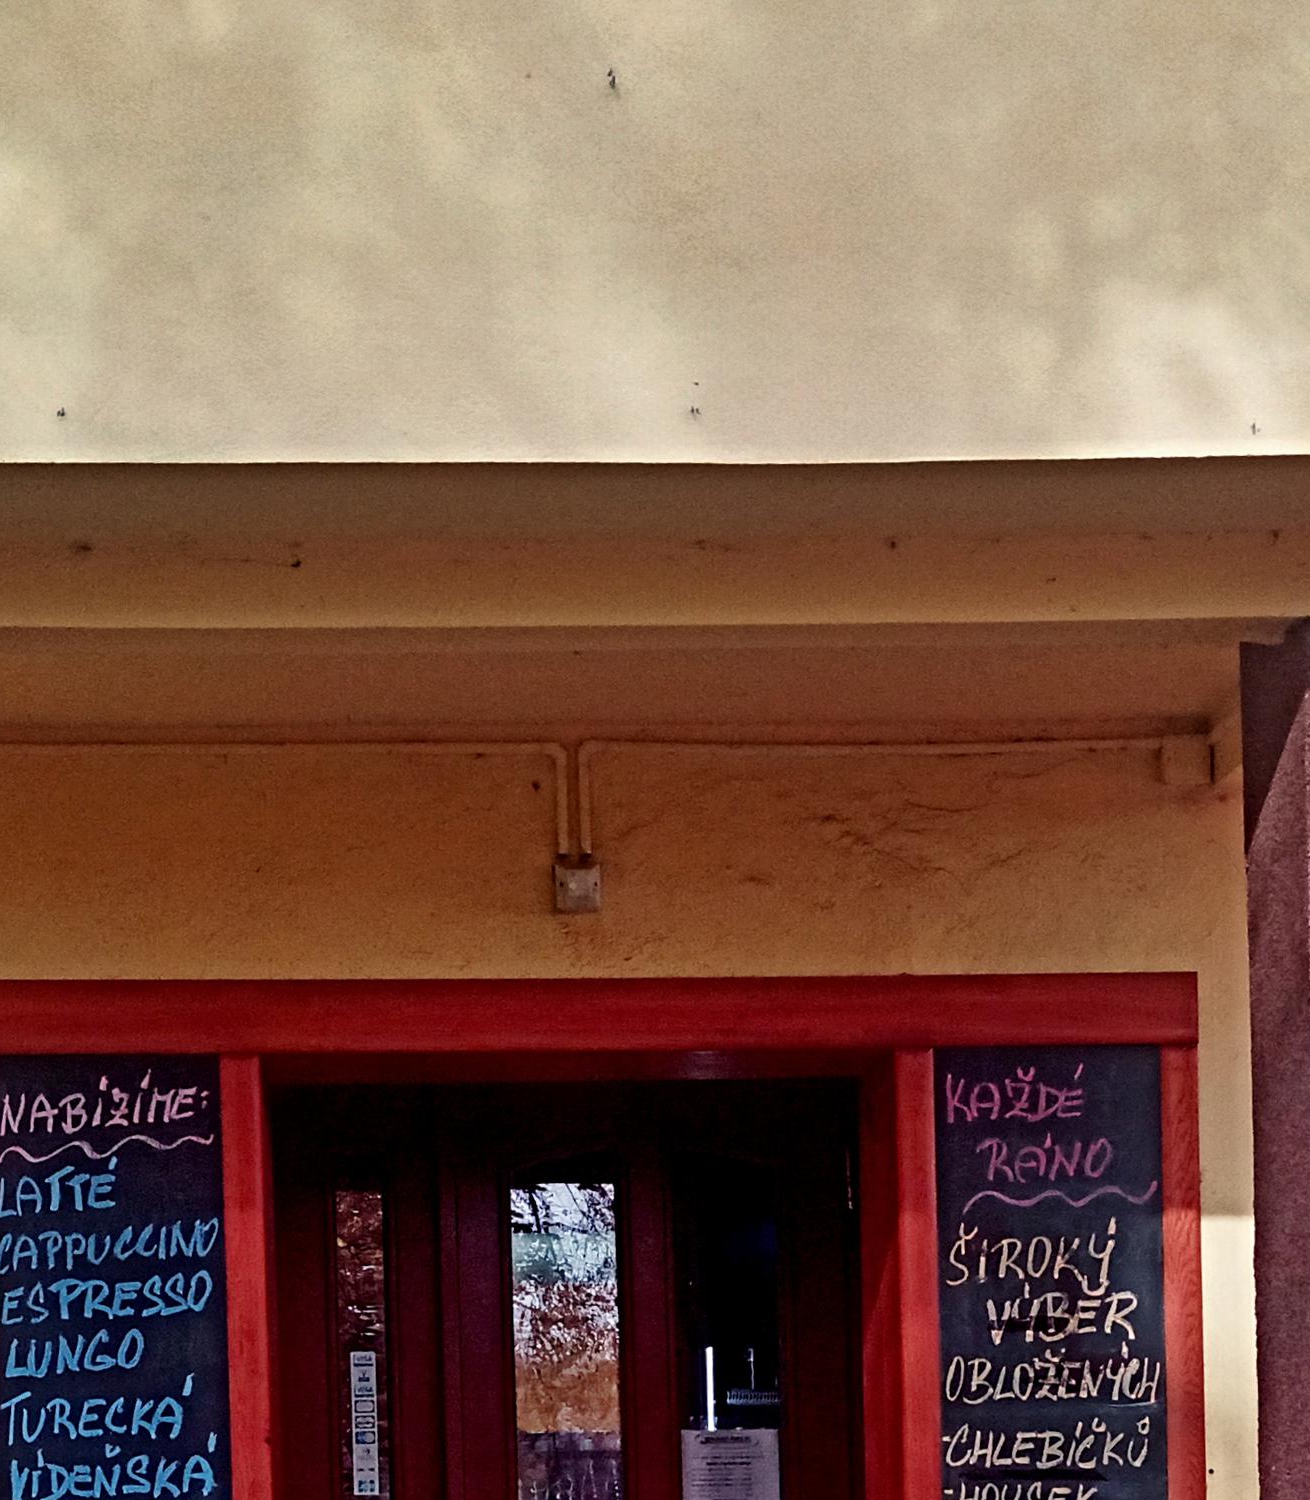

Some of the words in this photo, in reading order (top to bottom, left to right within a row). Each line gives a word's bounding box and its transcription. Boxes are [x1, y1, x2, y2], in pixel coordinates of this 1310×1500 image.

[946, 1063, 1083, 1124] KAŽDÉ
[977, 1132, 1114, 1183] RÁNO
[946, 1217, 1116, 1286] ŠIROKÝ
[1, 1269, 213, 1325] ESPRESSO
[5, 1328, 145, 1378] LUNGO
[946, 1341, 1161, 1405] OBLOŽENÝCH
[0, 1372, 195, 1446] TURECKÁ
